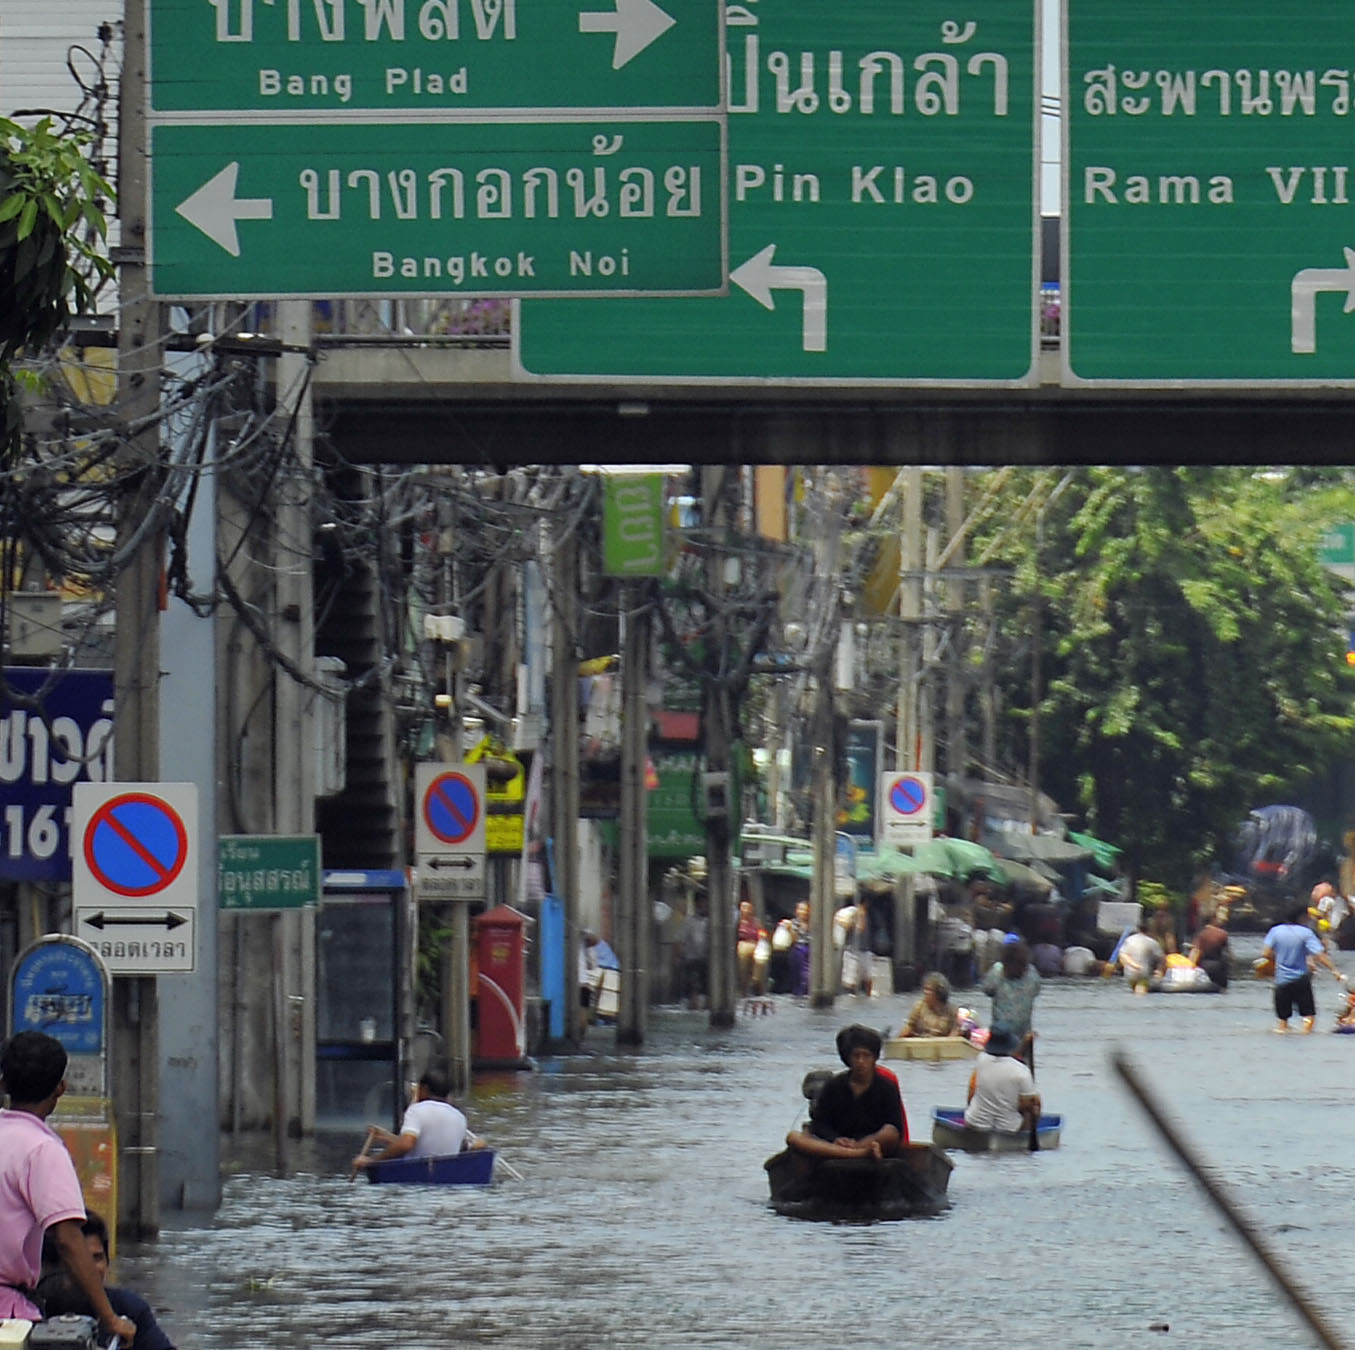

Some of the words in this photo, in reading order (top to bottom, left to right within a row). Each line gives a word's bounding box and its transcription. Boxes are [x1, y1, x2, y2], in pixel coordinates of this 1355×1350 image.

[259, 69, 351, 102] Bang
[386, 67, 468, 95] Plad
[299, 134, 702, 220] บางกอกน้อย
[736, 164, 820, 202] Pin
[852, 166, 974, 204] Klao
[1085, 166, 1234, 204] Rama
[1266, 166, 1349, 204] VII
[373, 251, 535, 285] Bangkok
[570, 248, 629, 276] Noi
